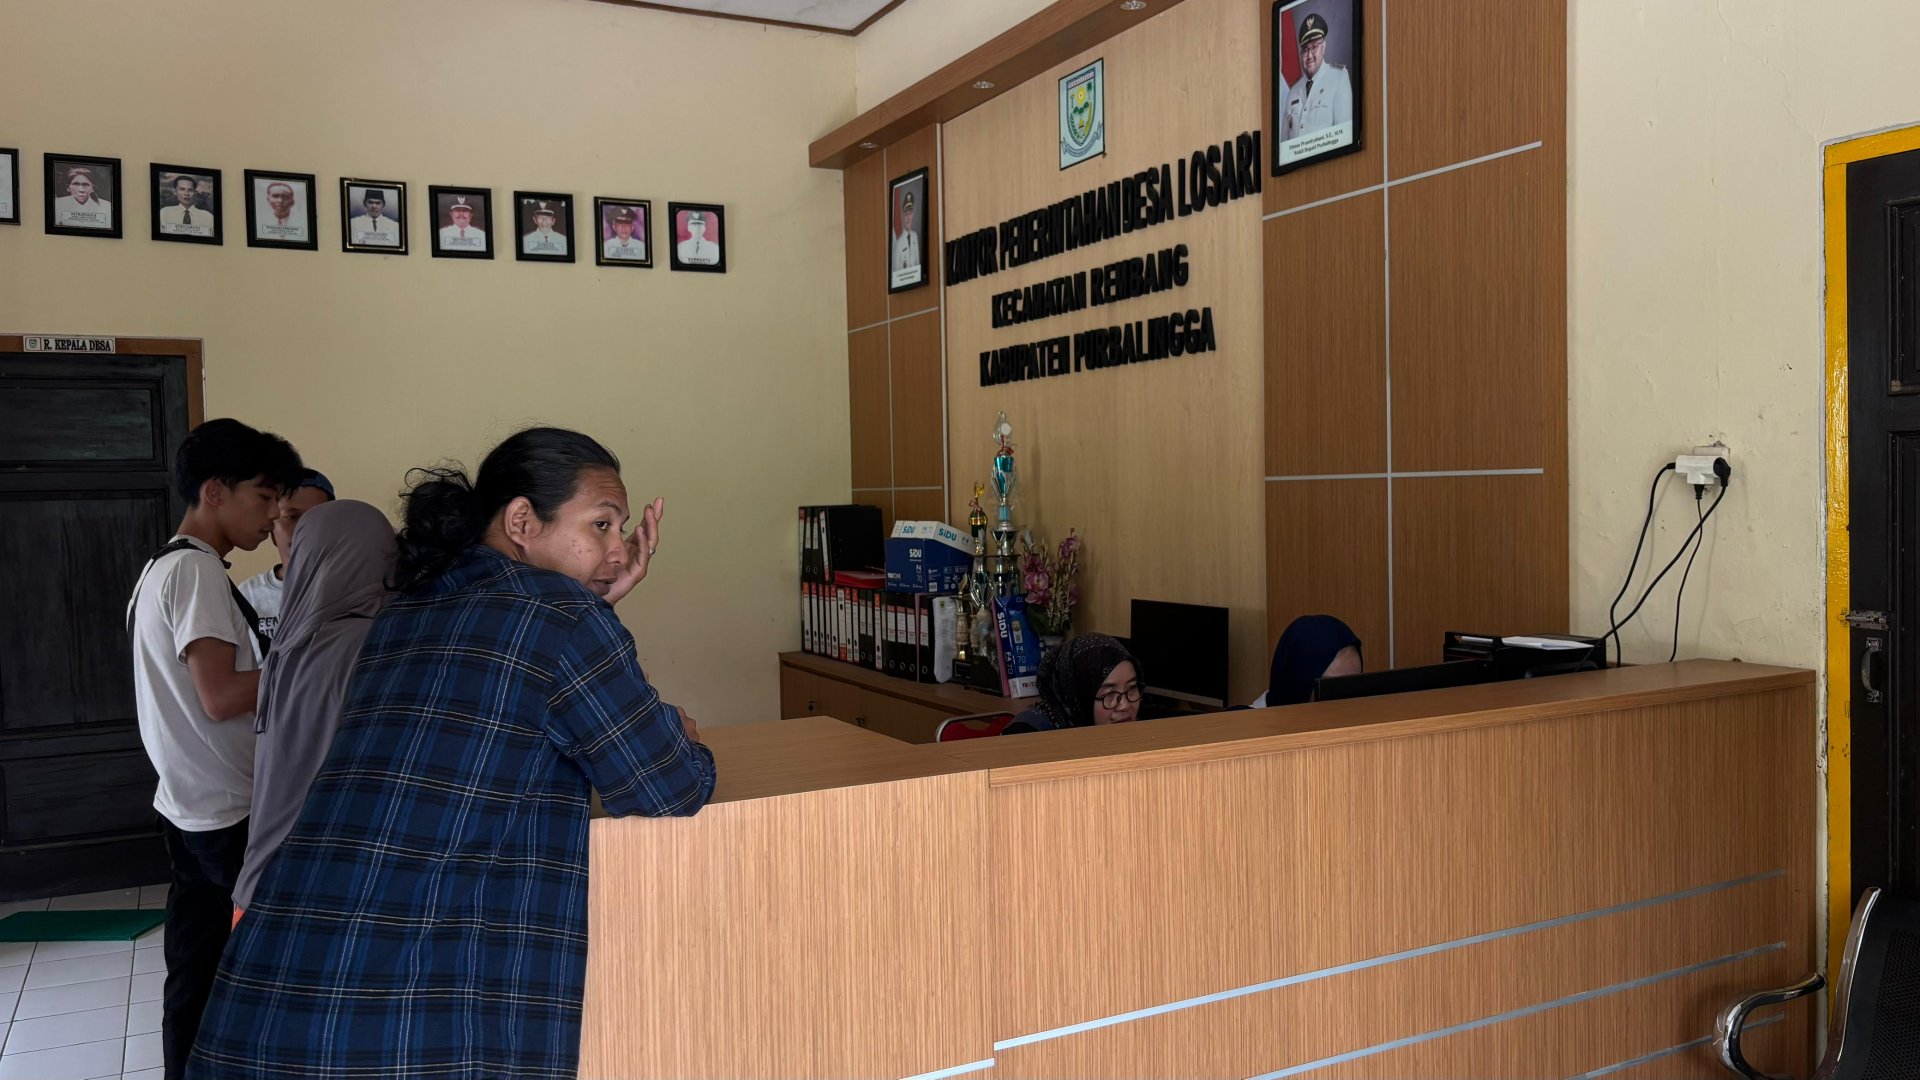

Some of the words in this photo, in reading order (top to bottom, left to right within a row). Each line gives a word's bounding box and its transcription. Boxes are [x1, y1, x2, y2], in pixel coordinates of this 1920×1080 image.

[945, 226, 998, 287] KANTOR
[999, 180, 1121, 271] PEMERINTAHAN
[1122, 163, 1174, 233] DESA
[1178, 130, 1262, 217] LOSARI
[991, 271, 1087, 329] KECAMATAN
[1090, 244, 1189, 307] REMBANG
[43, 338, 52, 350] R.
[54, 338, 87, 351] KEPALA
[89, 339, 111, 352] DESA
[979, 335, 1071, 387] KABUPATEN
[1073, 307, 1216, 372] PURBALINGGA
